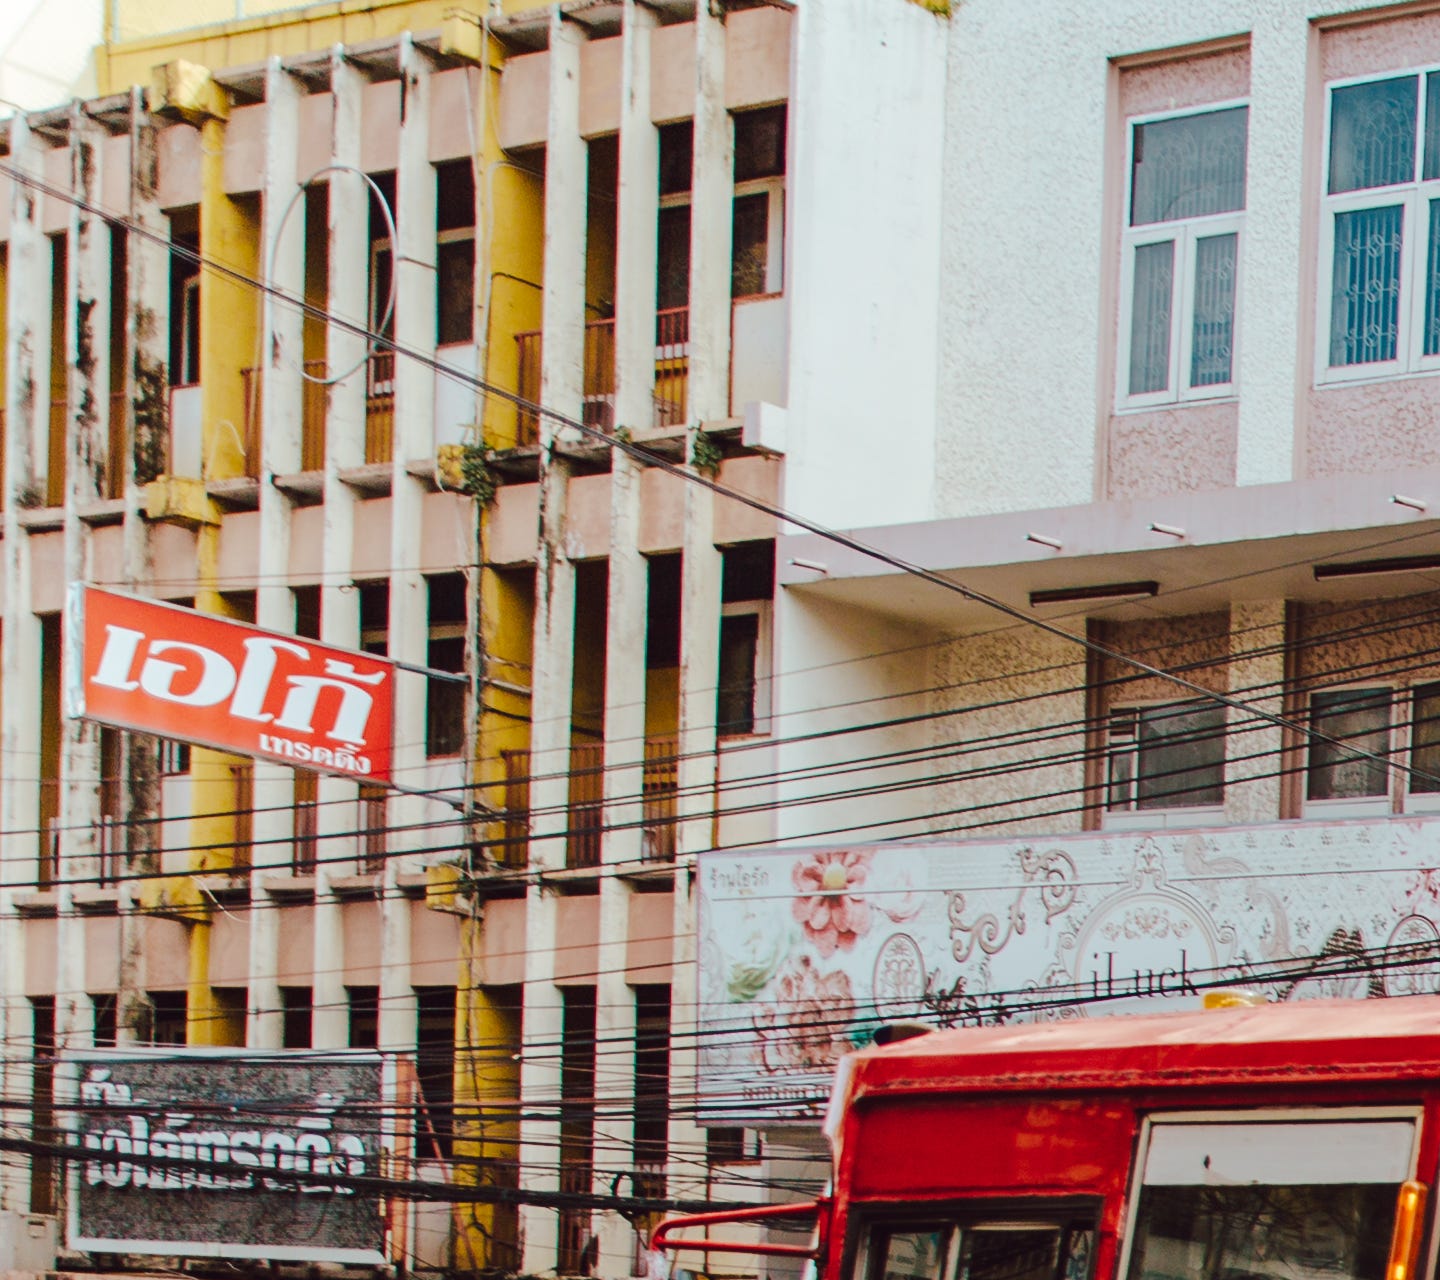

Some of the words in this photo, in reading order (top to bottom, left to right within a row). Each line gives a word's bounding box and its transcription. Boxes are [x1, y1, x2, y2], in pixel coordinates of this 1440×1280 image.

[91, 624, 386, 745] เอโก้
[259, 731, 373, 776] เทรดดิ้ง
[1090, 949, 1201, 999] iLuck
